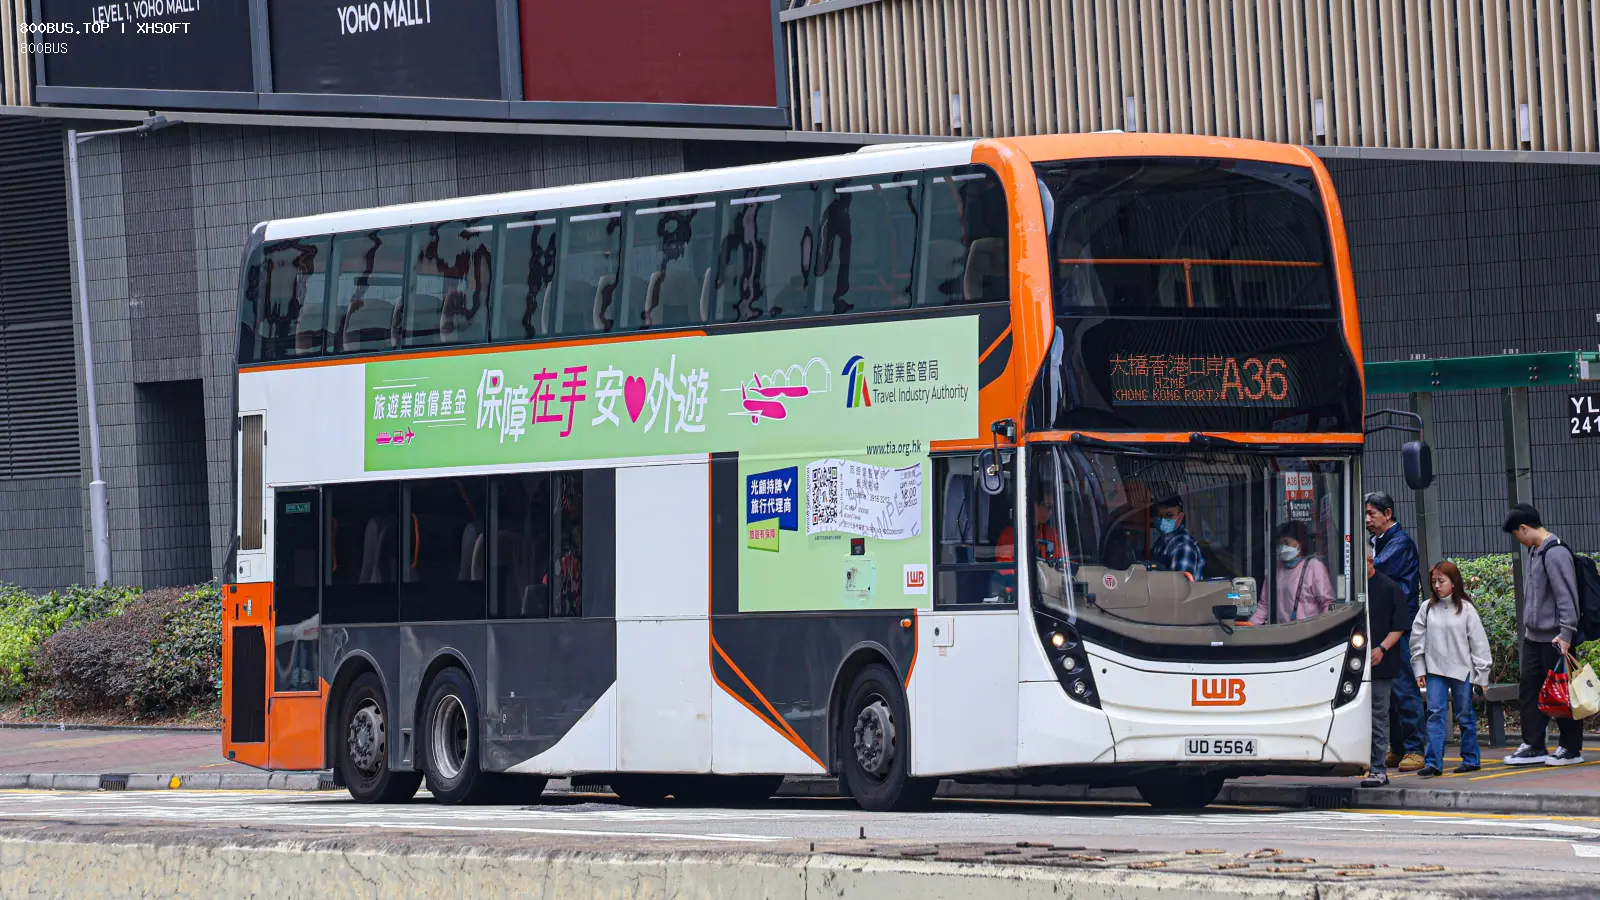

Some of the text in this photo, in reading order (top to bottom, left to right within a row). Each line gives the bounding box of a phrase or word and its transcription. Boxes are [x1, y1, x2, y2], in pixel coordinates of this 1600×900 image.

[93, 5, 123, 24] LEVEL
[134, 0, 163, 18] YOHO
[167, 0, 195, 14] MALL
[337, 2, 381, 35] YOHO
[383, 0, 423, 29] MALL
[873, 360, 939, 384] 旅遊業監管局
[1110, 354, 1224, 377] 大橋香港口岸
[1154, 377, 1185, 388] HZMB
[1221, 357, 1288, 400] A36
[873, 384, 969, 404] Travel Industry Authority
[1153, 389, 1180, 401] KONG
[372, 388, 467, 420] 旅遊業賠償基金
[476, 365, 588, 444] 保障在手
[866, 439, 921, 456] www.tia.org.hk
[750, 478, 783, 496] 光顧持牌
[1286, 476, 1298, 486] A36
[1301, 476, 1311, 486] E36
[750, 497, 792, 514] 旅行代理商
[749, 528, 776, 540] 旅遊有保障
[906, 570, 925, 588] LWB
[1191, 678, 1247, 706] LWB
[1189, 740, 1254, 754] UD 5564
